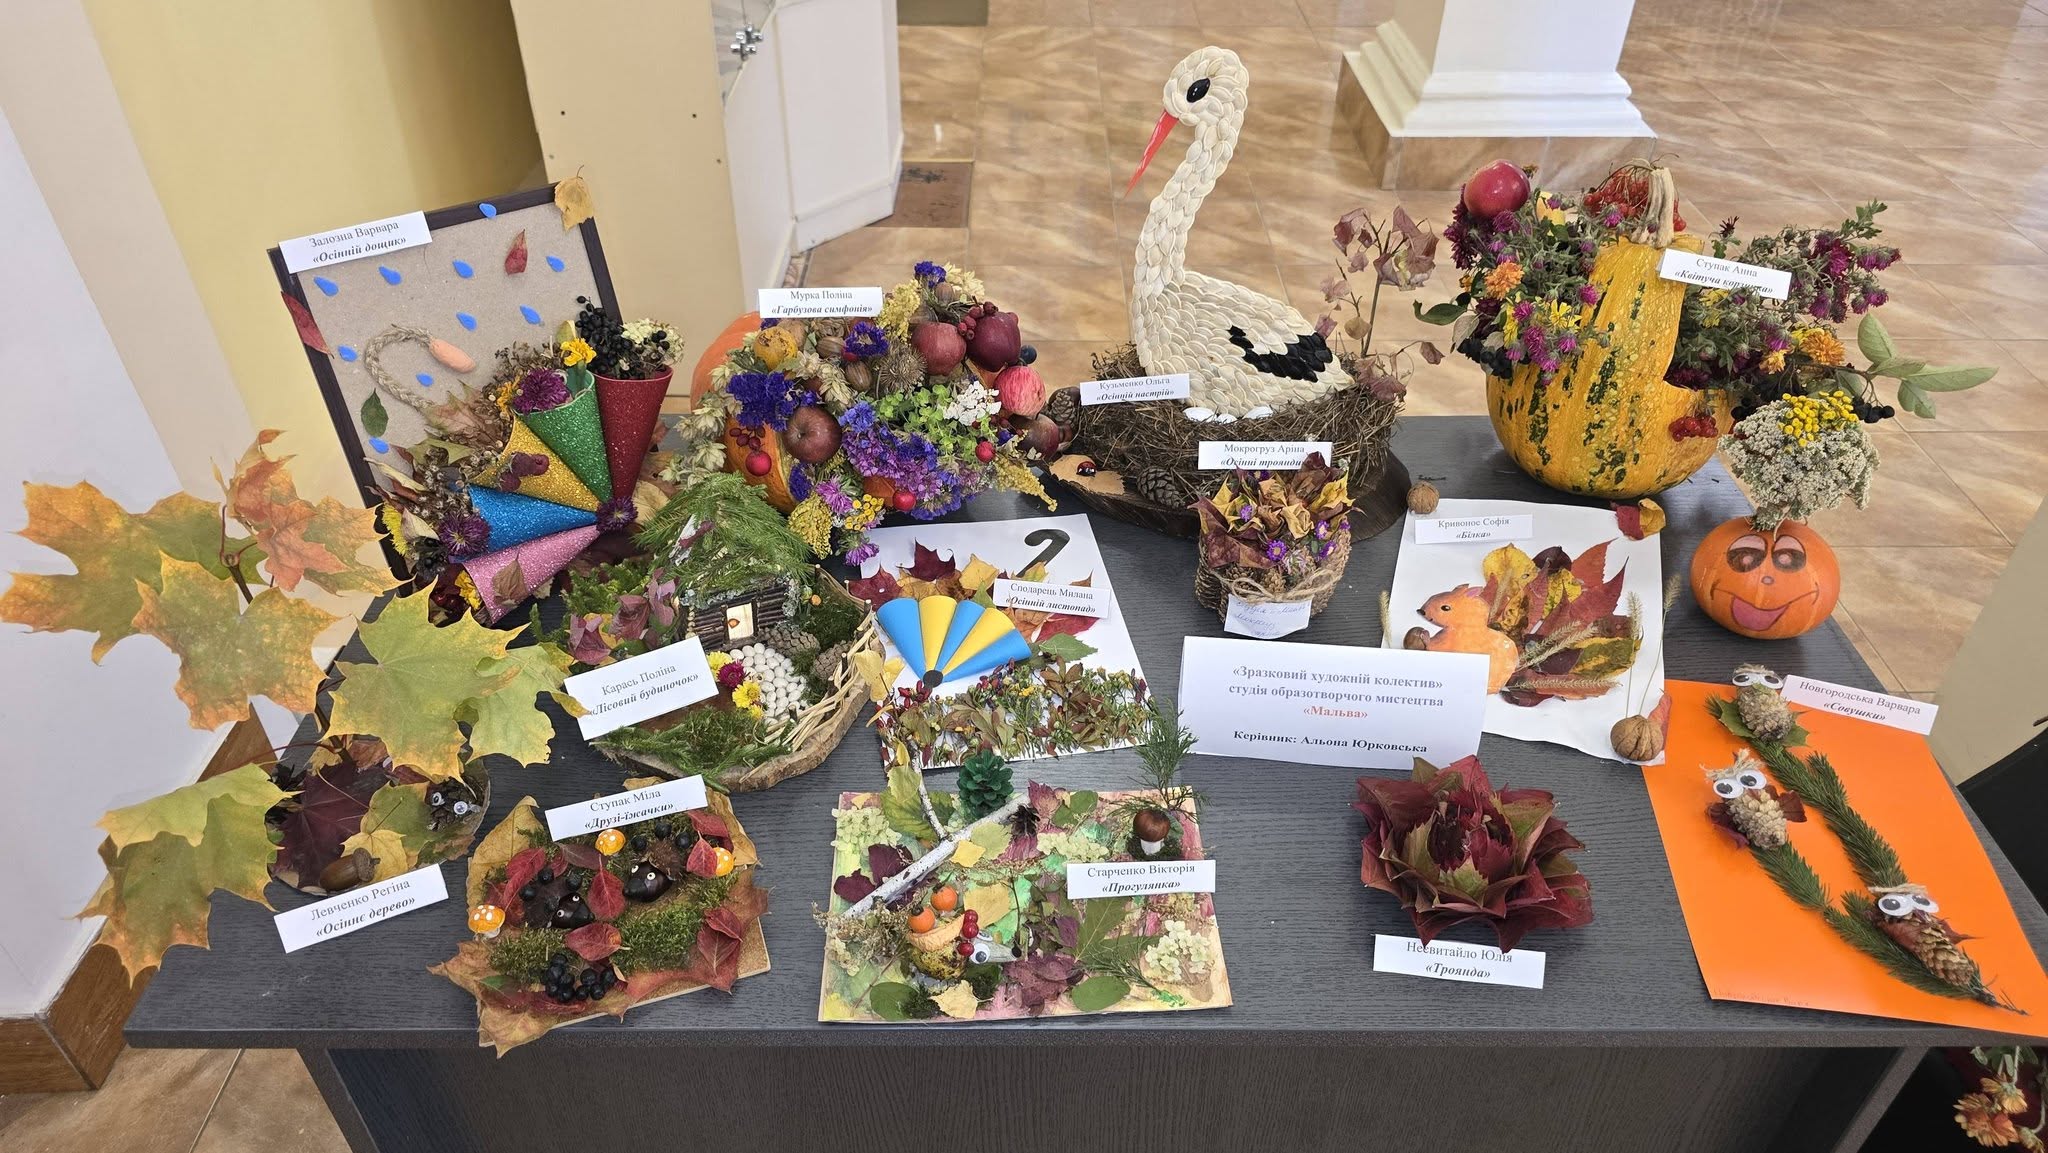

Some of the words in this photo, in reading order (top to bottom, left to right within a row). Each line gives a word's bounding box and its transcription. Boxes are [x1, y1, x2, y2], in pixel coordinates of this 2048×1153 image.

[309, 232, 353, 248] Залозна
[355, 222, 400, 238] Варвара
[312, 246, 362, 264] «Осінній
[364, 237, 406, 252] дощик»
[1674, 270, 1721, 284] «Квітуча
[1696, 258, 1730, 272] Ступак
[1732, 265, 1758, 278] Анна
[790, 290, 820, 302] Мурка
[822, 290, 853, 300] Поліна
[772, 305, 822, 316] «Гарбузова
[824, 304, 873, 315] симфонія»
[1100, 380, 1144, 391] Кузьменко
[1145, 377, 1170, 386] Ольга
[1096, 392, 1133, 401] «Осінній
[1135, 388, 1174, 399] настрій»
[1224, 444, 1275, 456] Мокрогруз
[1277, 444, 1305, 454] Аріна
[1220, 457, 1257, 466] «Осінні
[1258, 459, 1303, 468] троянди
[1438, 520, 1480, 530] Кривонос
[1482, 517, 1510, 528] Софія
[1456, 531, 1492, 540] «Білка»
[1010, 582, 1057, 596] Сподарець
[1059, 588, 1094, 600] Милана
[1046, 602, 1096, 614] листопад»
[602, 679, 638, 696] Карась
[640, 664, 677, 683] Поліна
[1232, 665, 1308, 681] «Зразковий
[1310, 671, 1371, 686] художній
[1374, 676, 1444, 690] колектив»
[640, 673, 699, 701] будиночок»
[1228, 684, 1268, 697] студія
[1271, 686, 1372, 704] образотворчого
[1375, 695, 1444, 708] мистецтва
[1800, 681, 1874, 704] Новгородська
[1876, 697, 1922, 715] Варвара
[1303, 705, 1369, 720] «Мальва»
[1824, 701, 1886, 722] «Совушки»
[1234, 730, 1298, 744] Керівник:
[1300, 736, 1348, 748] Альона
[1352, 739, 1428, 753] Юрковська
[590, 798, 631, 812] Ступак
[633, 789, 662, 804] Міла
[584, 802, 674, 830] «Друзі-їжачки»
[1087, 867, 1146, 880] Старченко
[1149, 863, 1196, 876] Вікторія
[1102, 880, 1181, 894] «Прогулянка»
[311, 894, 370, 921] Левченко
[371, 880, 411, 900] Регіна
[316, 914, 366, 938] «Осіннє
[369, 897, 416, 920] дерево»
[1426, 962, 1491, 978] «Троянда»
